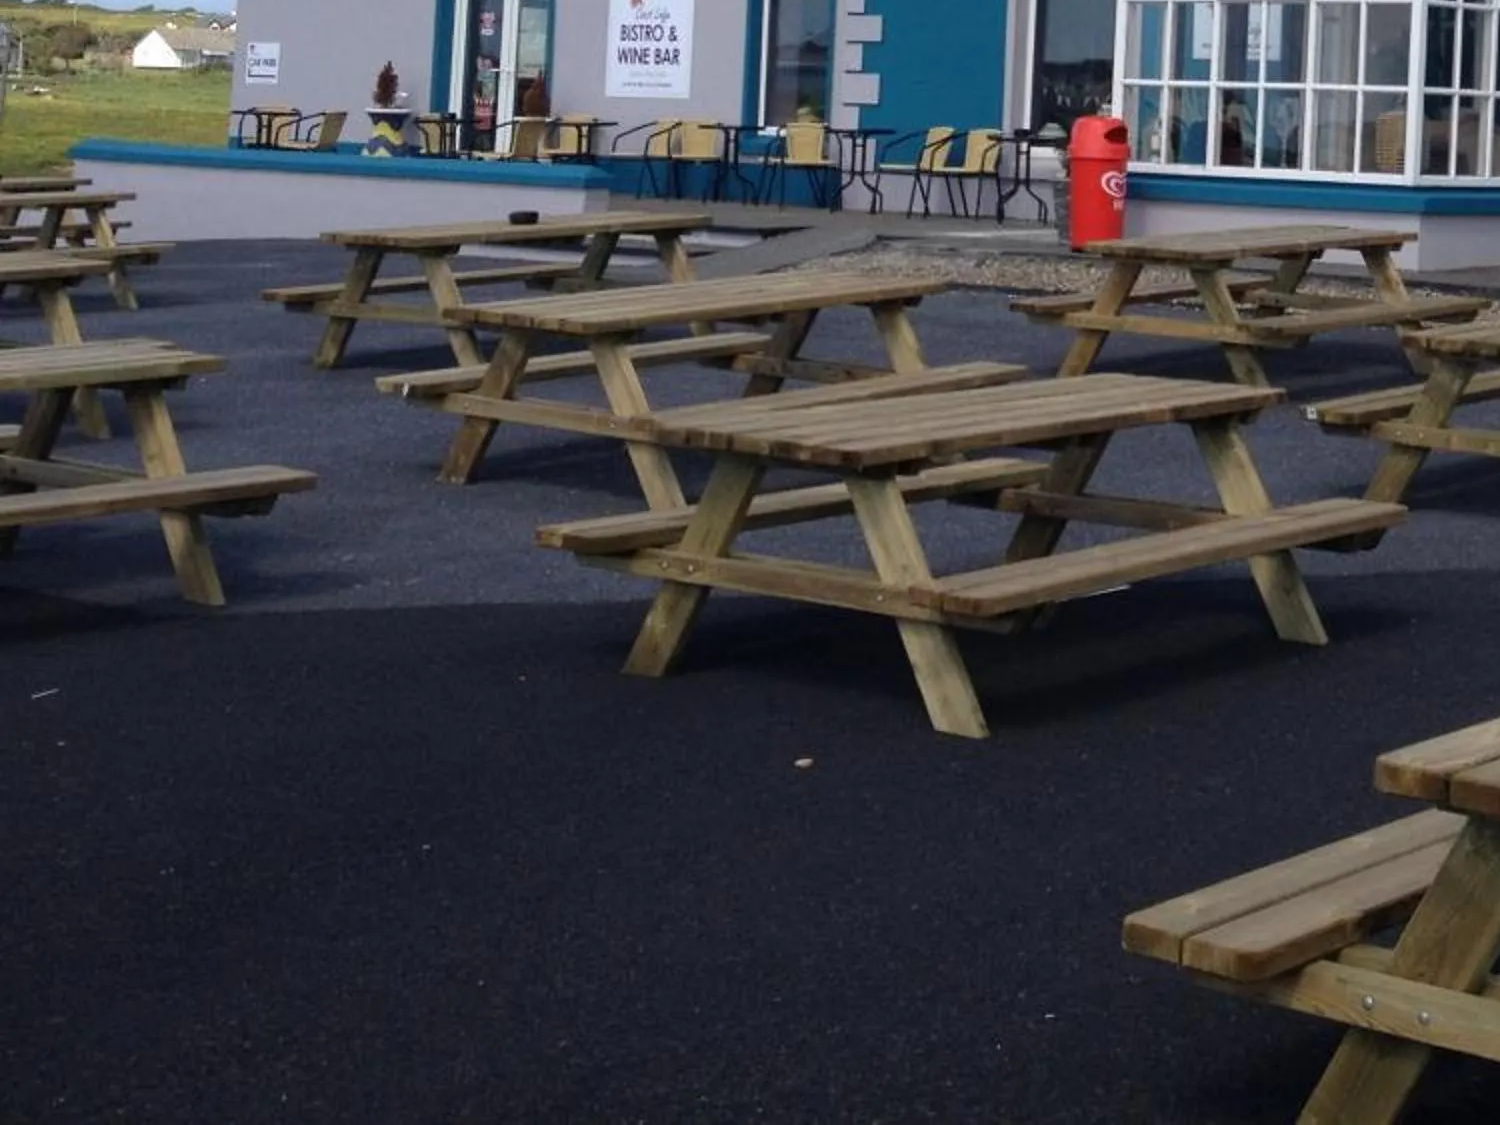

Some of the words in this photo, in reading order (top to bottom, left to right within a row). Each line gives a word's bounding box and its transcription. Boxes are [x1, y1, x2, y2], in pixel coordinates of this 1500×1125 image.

[620, 24, 664, 42] BISTRO
[668, 25, 678, 42] &
[617, 46, 650, 65] WINE
[653, 48, 681, 66] BAR
